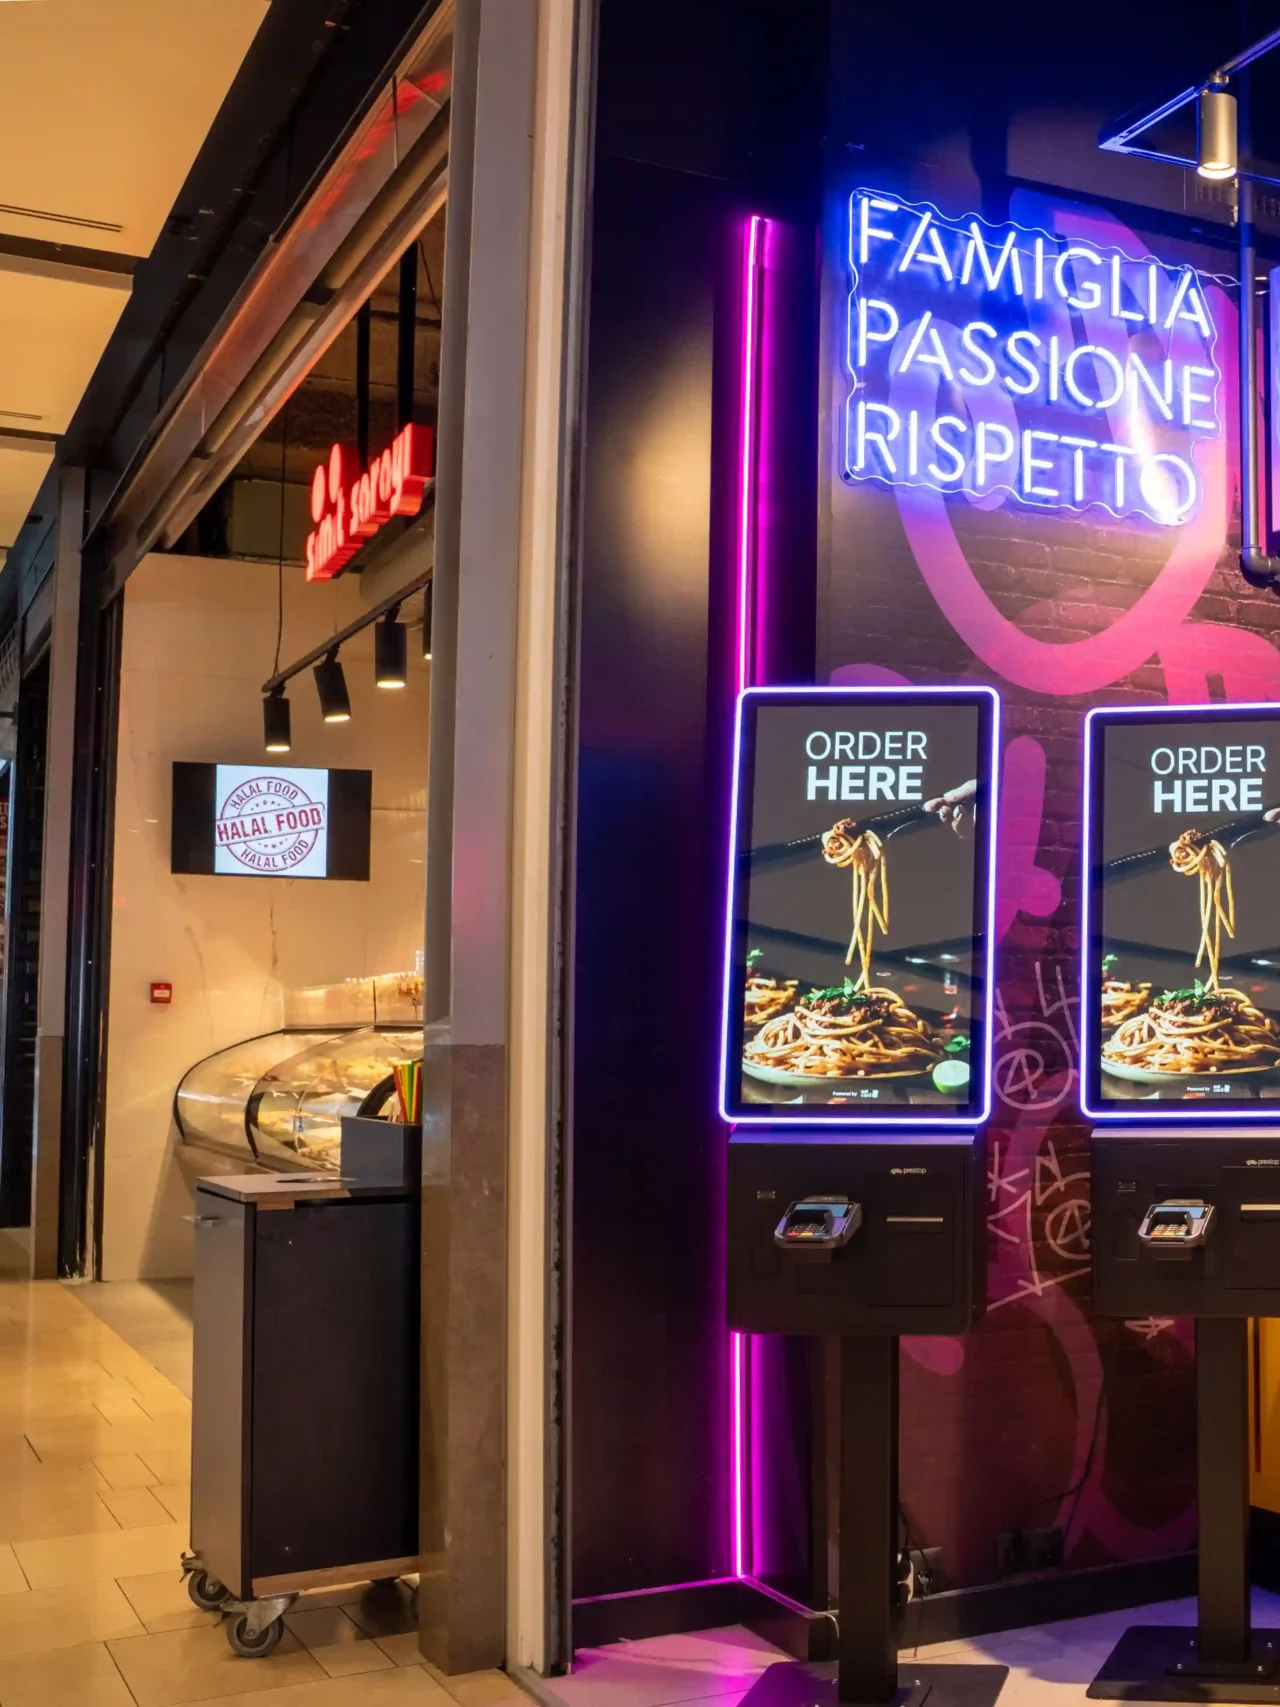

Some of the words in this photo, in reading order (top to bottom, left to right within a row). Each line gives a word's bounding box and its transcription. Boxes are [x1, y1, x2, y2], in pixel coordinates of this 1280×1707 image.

[860, 197, 1211, 338] FAMIGLIA
[858, 297, 1216, 429] PASSIONE
[856, 400, 1196, 522] RISPETTO
[805, 731, 928, 761] ORDER
[1151, 745, 1267, 775] ORDER
[230, 782, 263, 810] HALAL
[266, 781, 299, 801] FOOD
[806, 765, 923, 801] HERE
[1153, 778, 1263, 813] HERE
[217, 818, 271, 842] HALAL
[276, 807, 322, 832] FOOD
[240, 849, 279, 868] HALAL
[282, 839, 309, 868] FOOD
